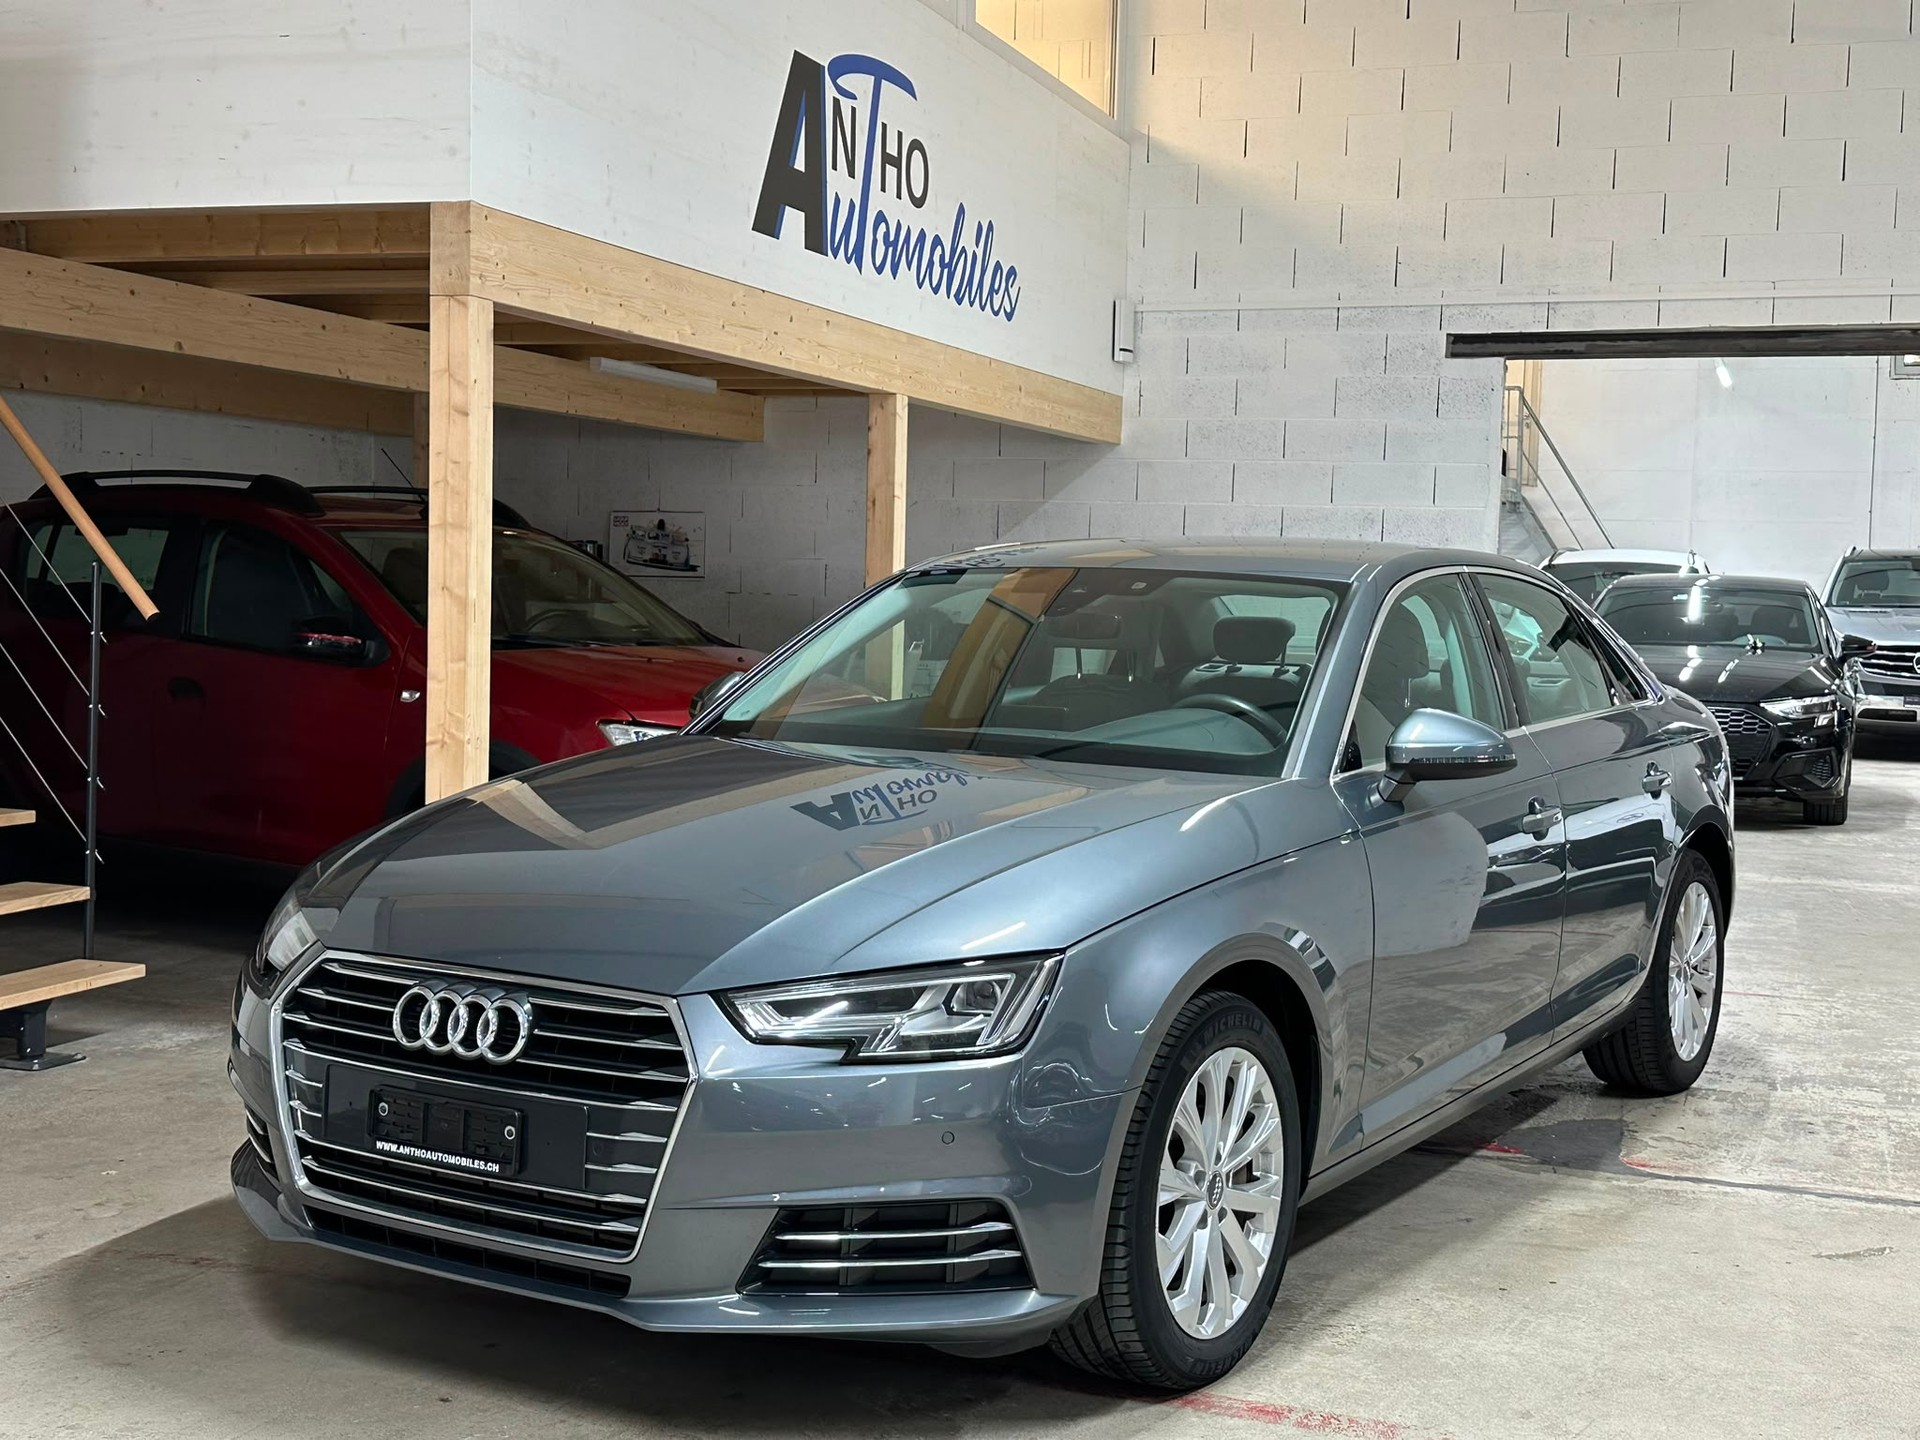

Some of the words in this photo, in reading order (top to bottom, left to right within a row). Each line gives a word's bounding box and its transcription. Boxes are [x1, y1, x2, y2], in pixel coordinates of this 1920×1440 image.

[752, 49, 929, 257] ANTHO
[1201, 1013, 1262, 1045] MICHELIN
[376, 1141, 499, 1172] WWW.ANTHOAUTOMOBILES.CH
